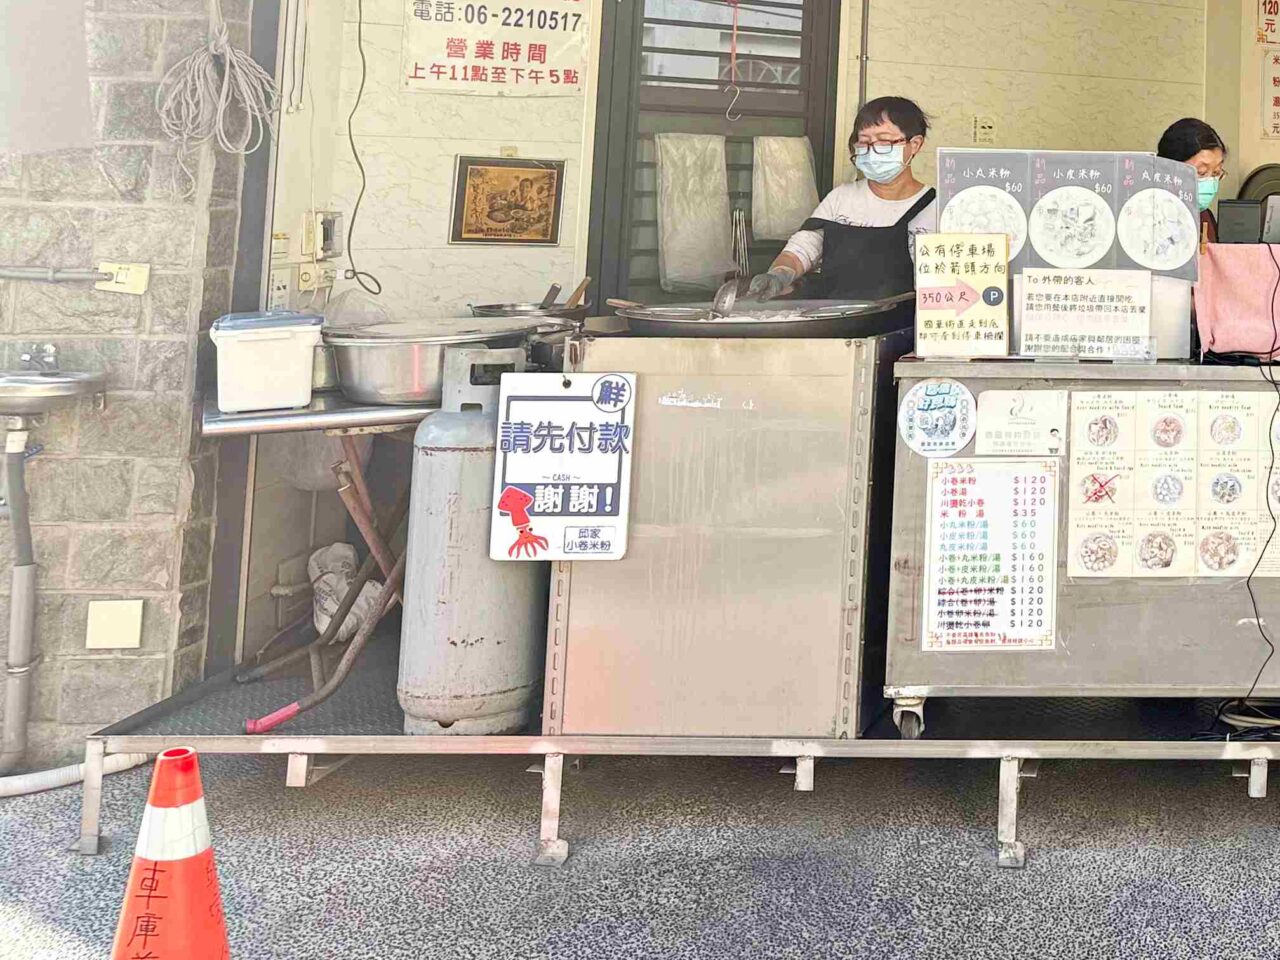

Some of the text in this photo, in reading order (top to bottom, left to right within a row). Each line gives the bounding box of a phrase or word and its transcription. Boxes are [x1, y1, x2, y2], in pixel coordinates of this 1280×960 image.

[445, 37, 548, 65] 營業時間
[408, 61, 579, 86] 上午11點至下午5點
[1004, 181, 1023, 193] $60
[1094, 182, 1113, 194] $60
[1178, 189, 1193, 202] $60
[919, 242, 996, 258] 公有停車場
[918, 261, 1006, 275] 位於箭頭方向
[596, 379, 628, 408] 鮮
[500, 420, 631, 455] 請先付款
[552, 473, 571, 482] CASH
[127, 861, 169, 960] 車庫
